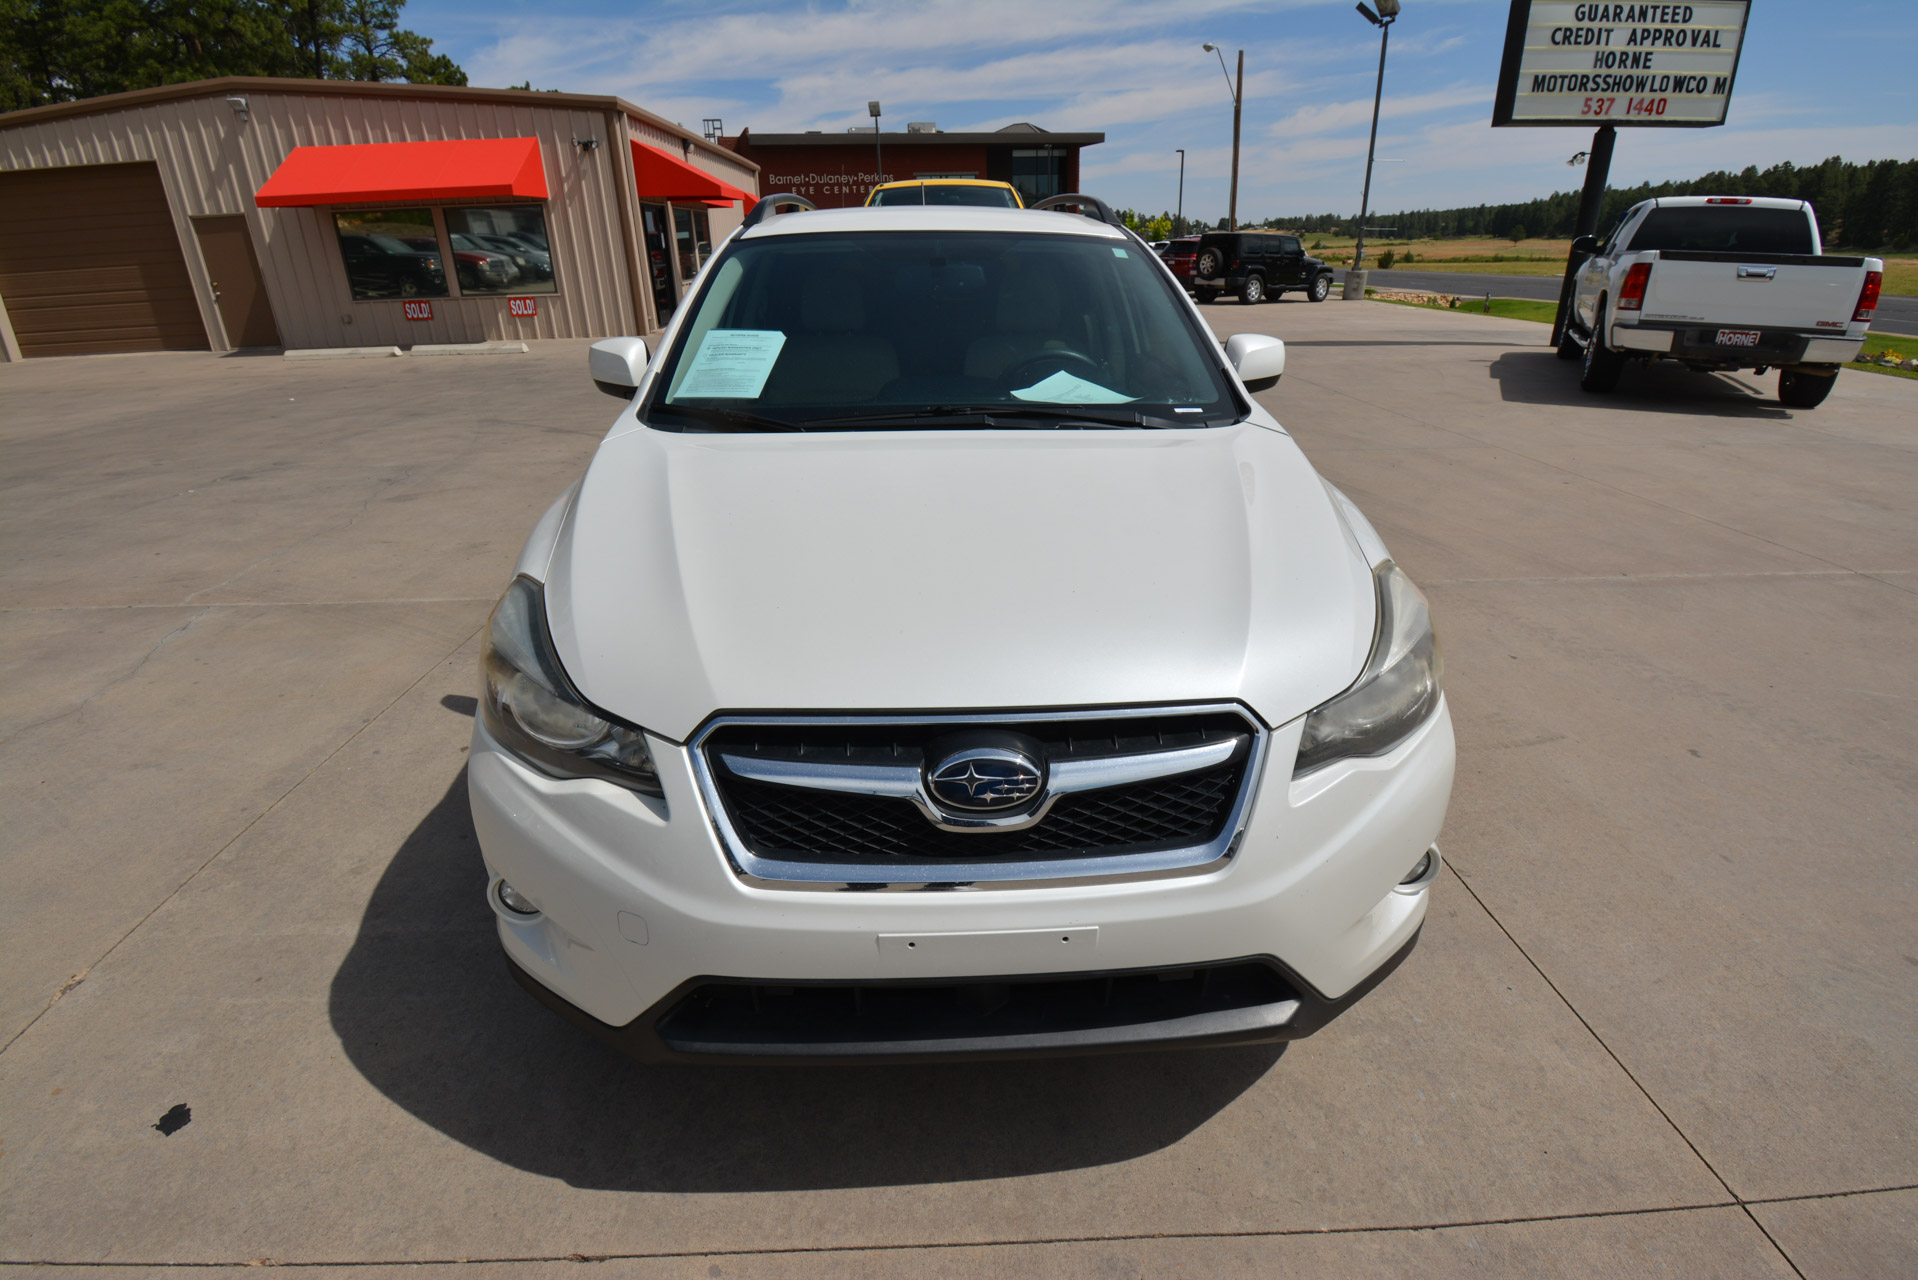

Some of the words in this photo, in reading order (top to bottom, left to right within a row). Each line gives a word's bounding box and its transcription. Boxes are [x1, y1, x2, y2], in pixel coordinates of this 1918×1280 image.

[1574, 4, 1693, 24] GUARANTEED
[1551, 27, 1614, 46] CREDIT
[1626, 28, 1721, 48] APPROVAL
[1593, 51, 1653, 69] HORNE
[1581, 97, 1616, 116] 537
[1626, 97, 1667, 116] 1440
[792, 187, 815, 195] EYE
[405, 303, 431, 319] SOLD!
[510, 299, 535, 315] SOLD!
[1816, 320, 1844, 328] GMC
[1717, 333, 1757, 346] HORNE
